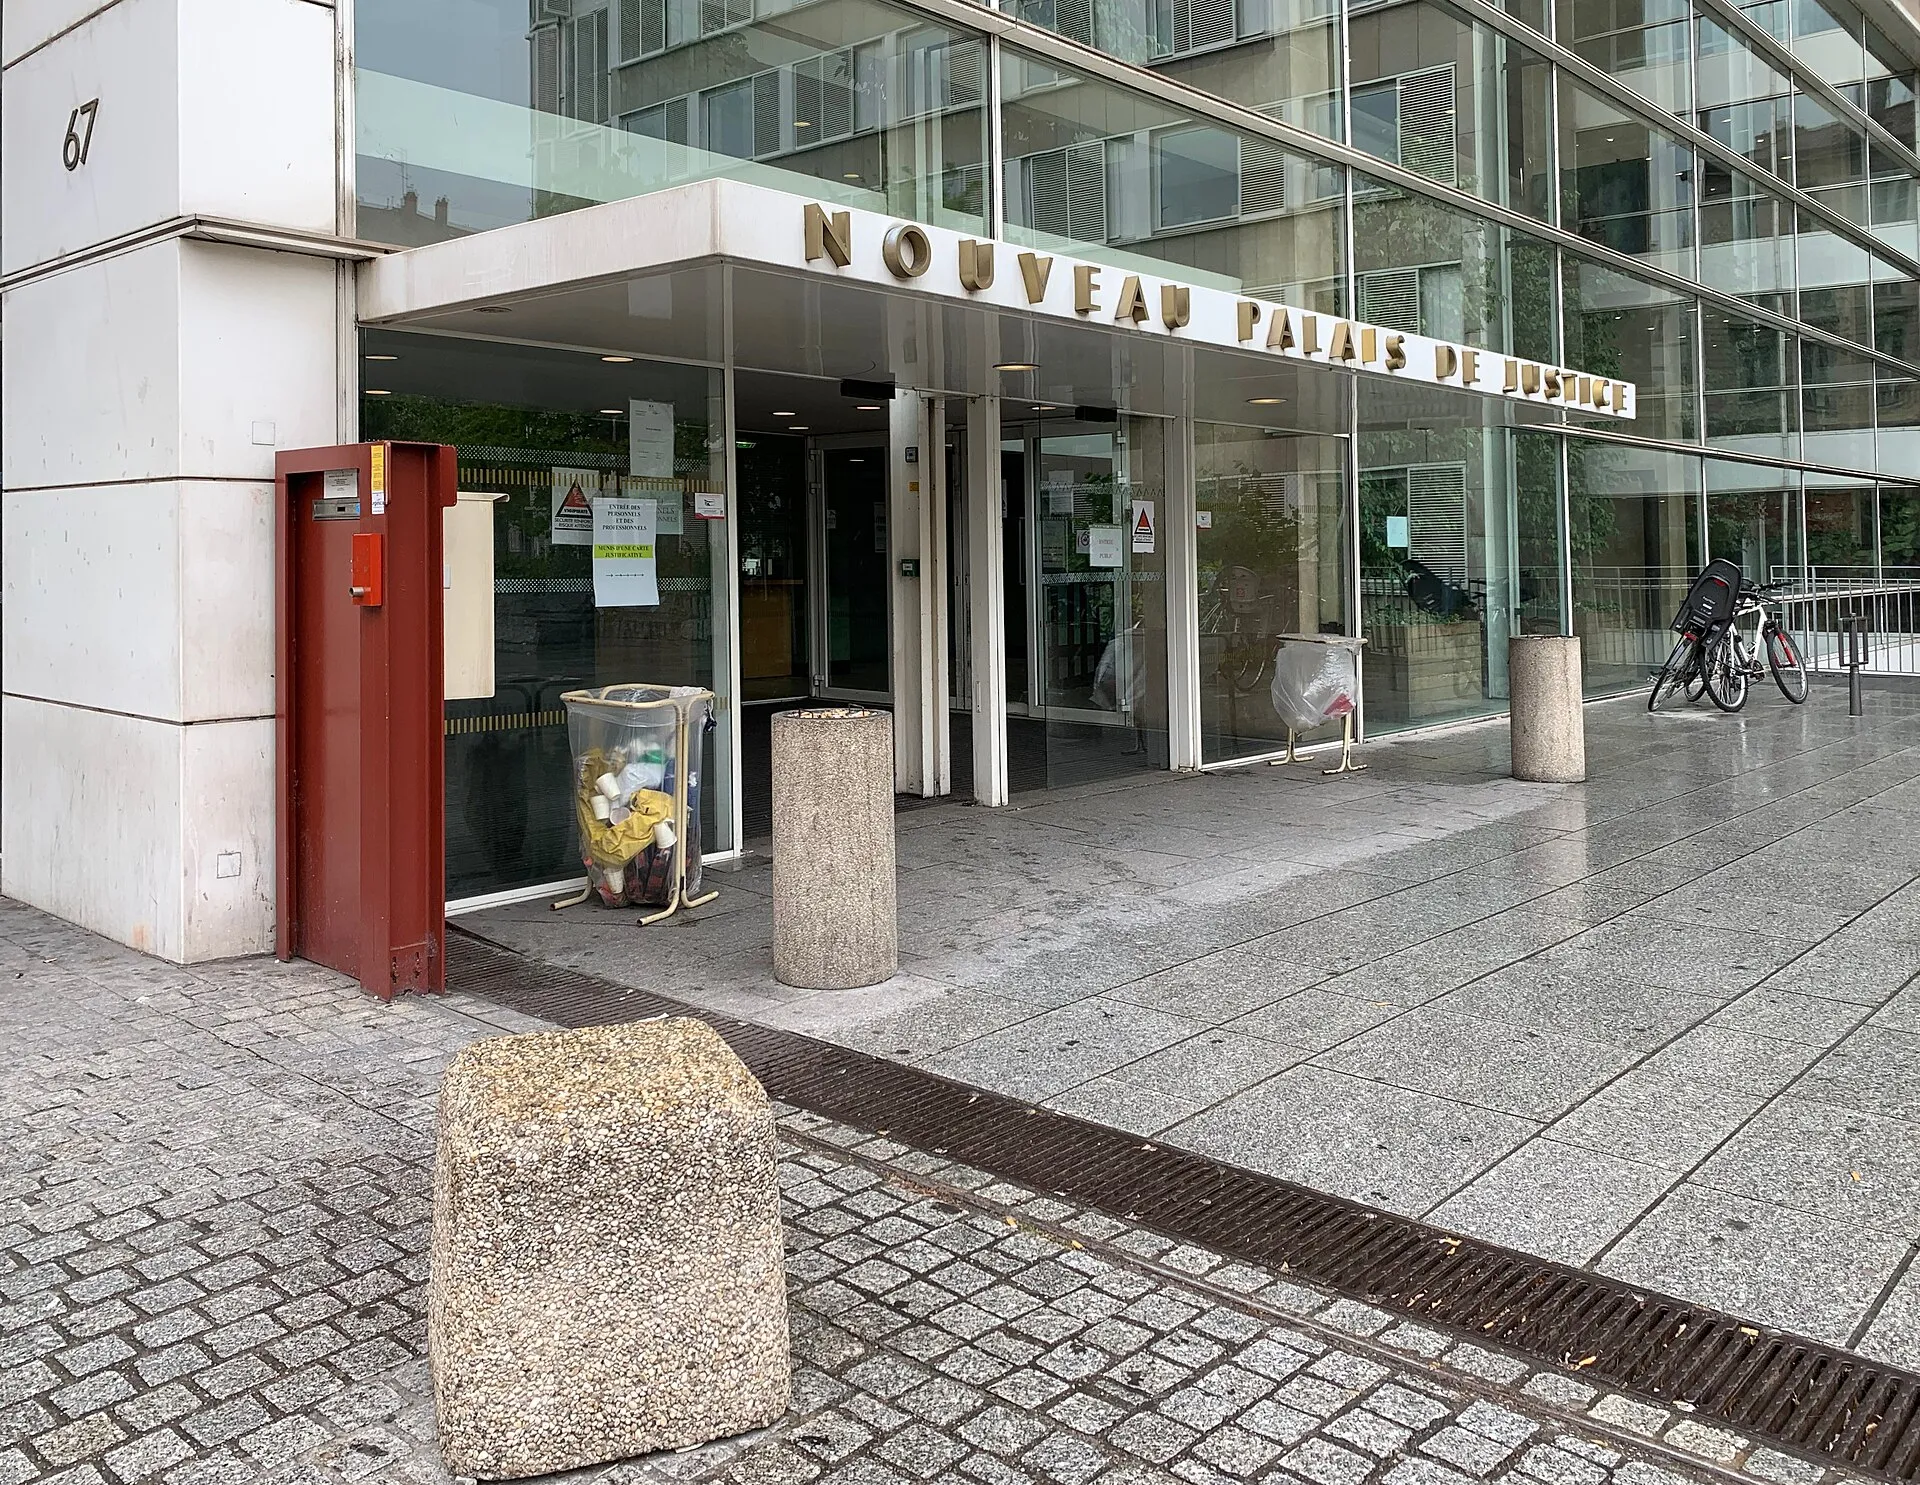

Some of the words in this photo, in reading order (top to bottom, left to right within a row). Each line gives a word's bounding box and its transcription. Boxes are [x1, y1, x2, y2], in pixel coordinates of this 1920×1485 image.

[63, 98, 99, 171] 67
[803, 203, 1191, 329] NOUVEAU
[1237, 301, 1406, 371] PALAIS
[1435, 344, 1480, 383] DE
[1503, 360, 1628, 412] JUSTICE
